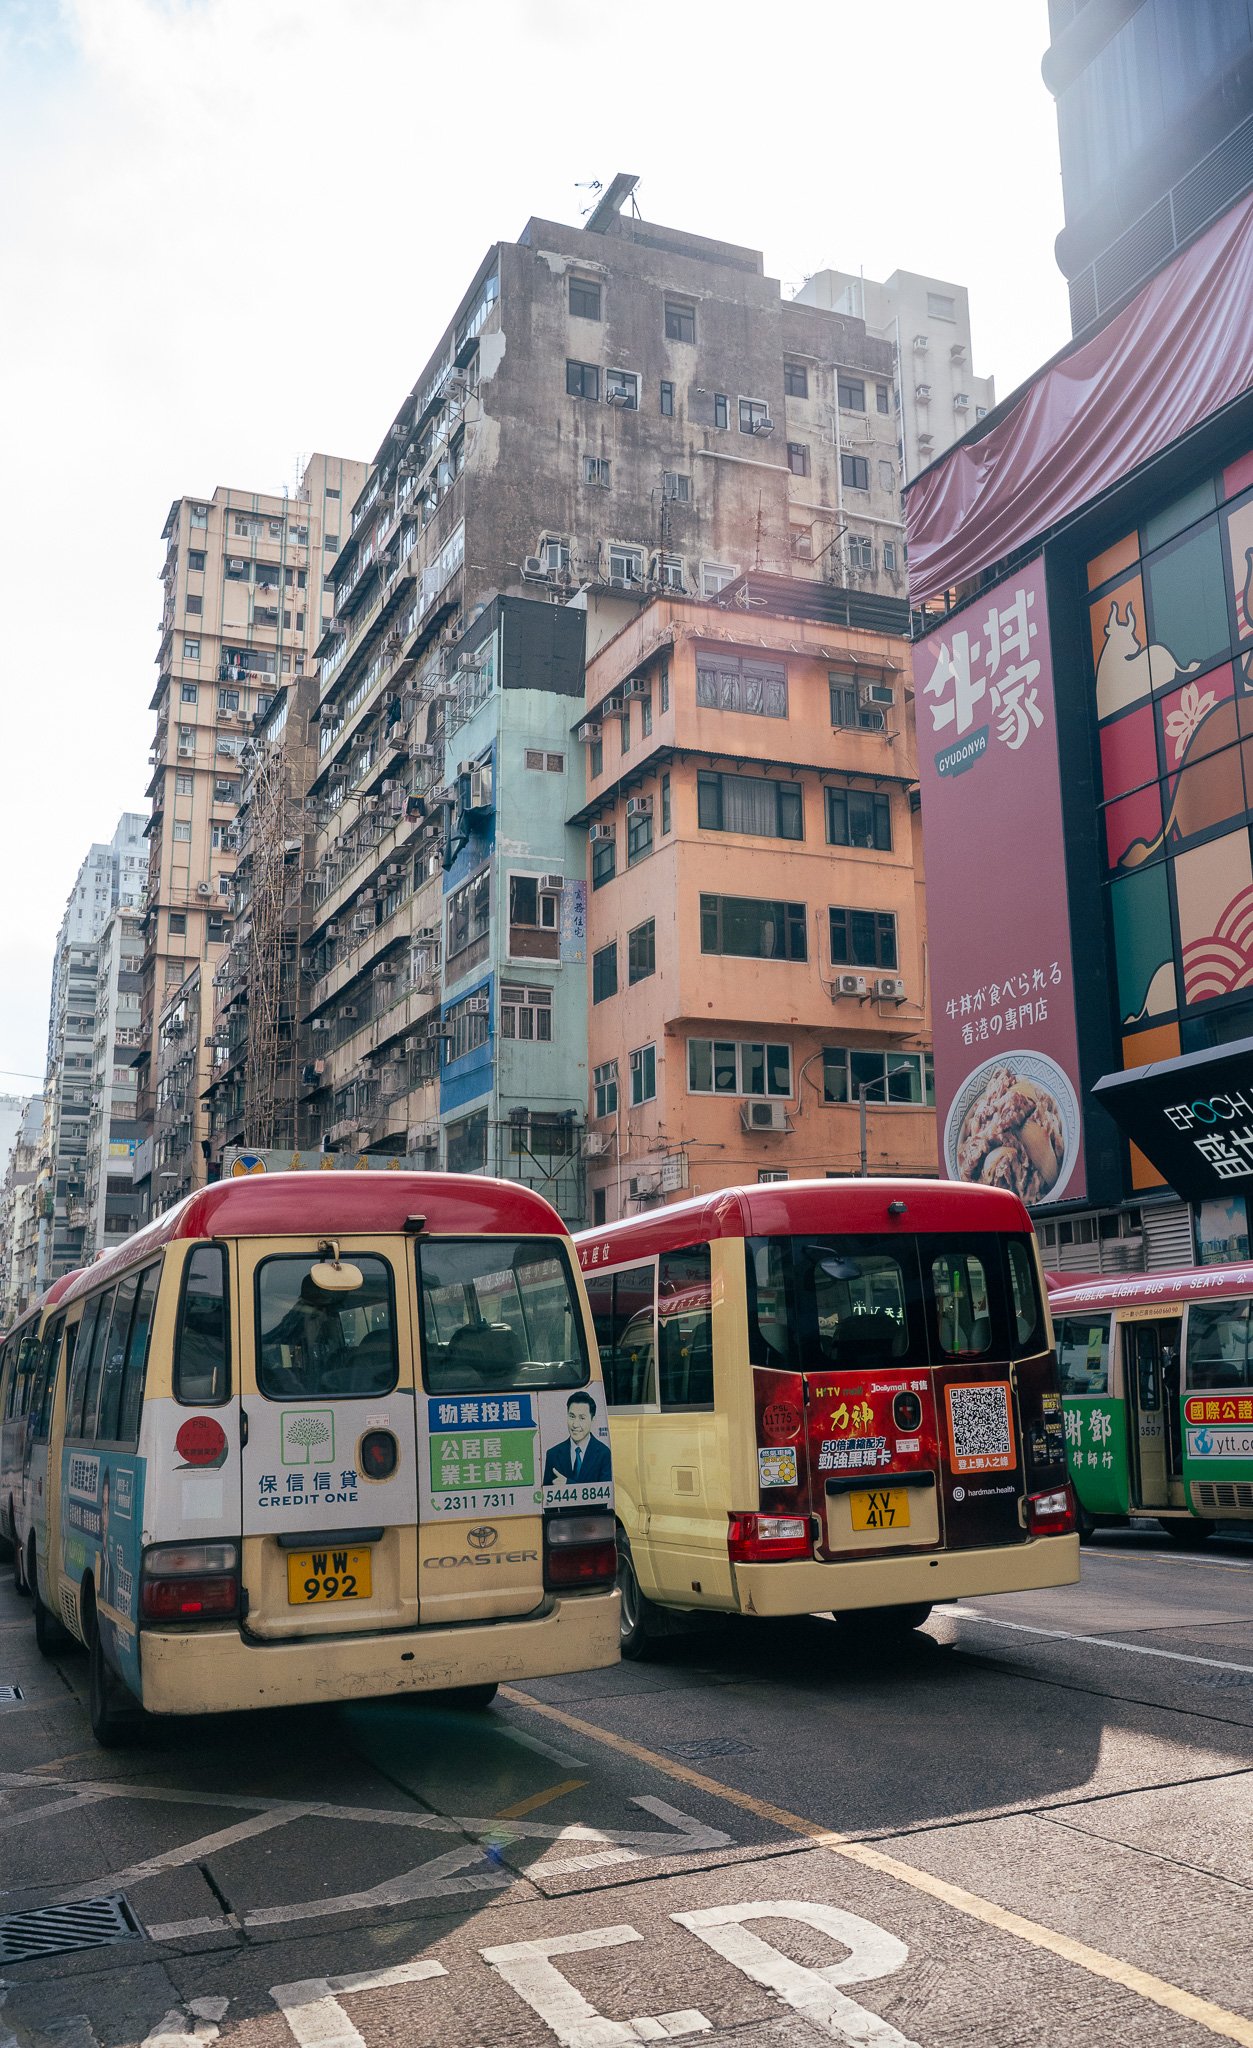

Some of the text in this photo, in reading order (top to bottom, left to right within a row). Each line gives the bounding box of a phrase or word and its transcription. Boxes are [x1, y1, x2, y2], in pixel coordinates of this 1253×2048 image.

[937, 736, 987, 772] GYUDONYA
[945, 961, 1062, 1020] 牛丼が食べられる
[1073, 1288, 1105, 1302] PUBLIC
[1112, 1284, 1140, 1298] LIGHT
[1144, 1284, 1165, 1295] BUS
[1172, 1281, 1182, 1292] 16
[1189, 1276, 1225, 1289] SEATS
[910, 1380, 928, 1391] 有售
[438, 1401, 521, 1424] 物業按揭
[772, 1404, 789, 1412] PSL
[830, 1401, 874, 1432] 力神
[1190, 1400, 1253, 1420] 國際公證
[192, 1420, 209, 1429] PSL
[1140, 1426, 1161, 1437] 3557
[440, 1438, 502, 1461] 公居屋
[818, 1449, 892, 1470] 勁強黑瑪卡
[441, 1460, 524, 1486] 業主貸款
[958, 1457, 1009, 1470] 登上男人之峰
[258, 1470, 358, 1494] 保信信貸
[968, 1485, 1015, 1497] hardman.health
[258, 1491, 358, 1508] CREDIT ONE
[443, 1493, 515, 1511] 2311 7311
[546, 1486, 611, 1503] 5444 8844
[867, 1492, 890, 1511] XV
[866, 1509, 896, 1527] 417
[423, 1549, 539, 1569] COASTER
[304, 1575, 358, 1600] 992
